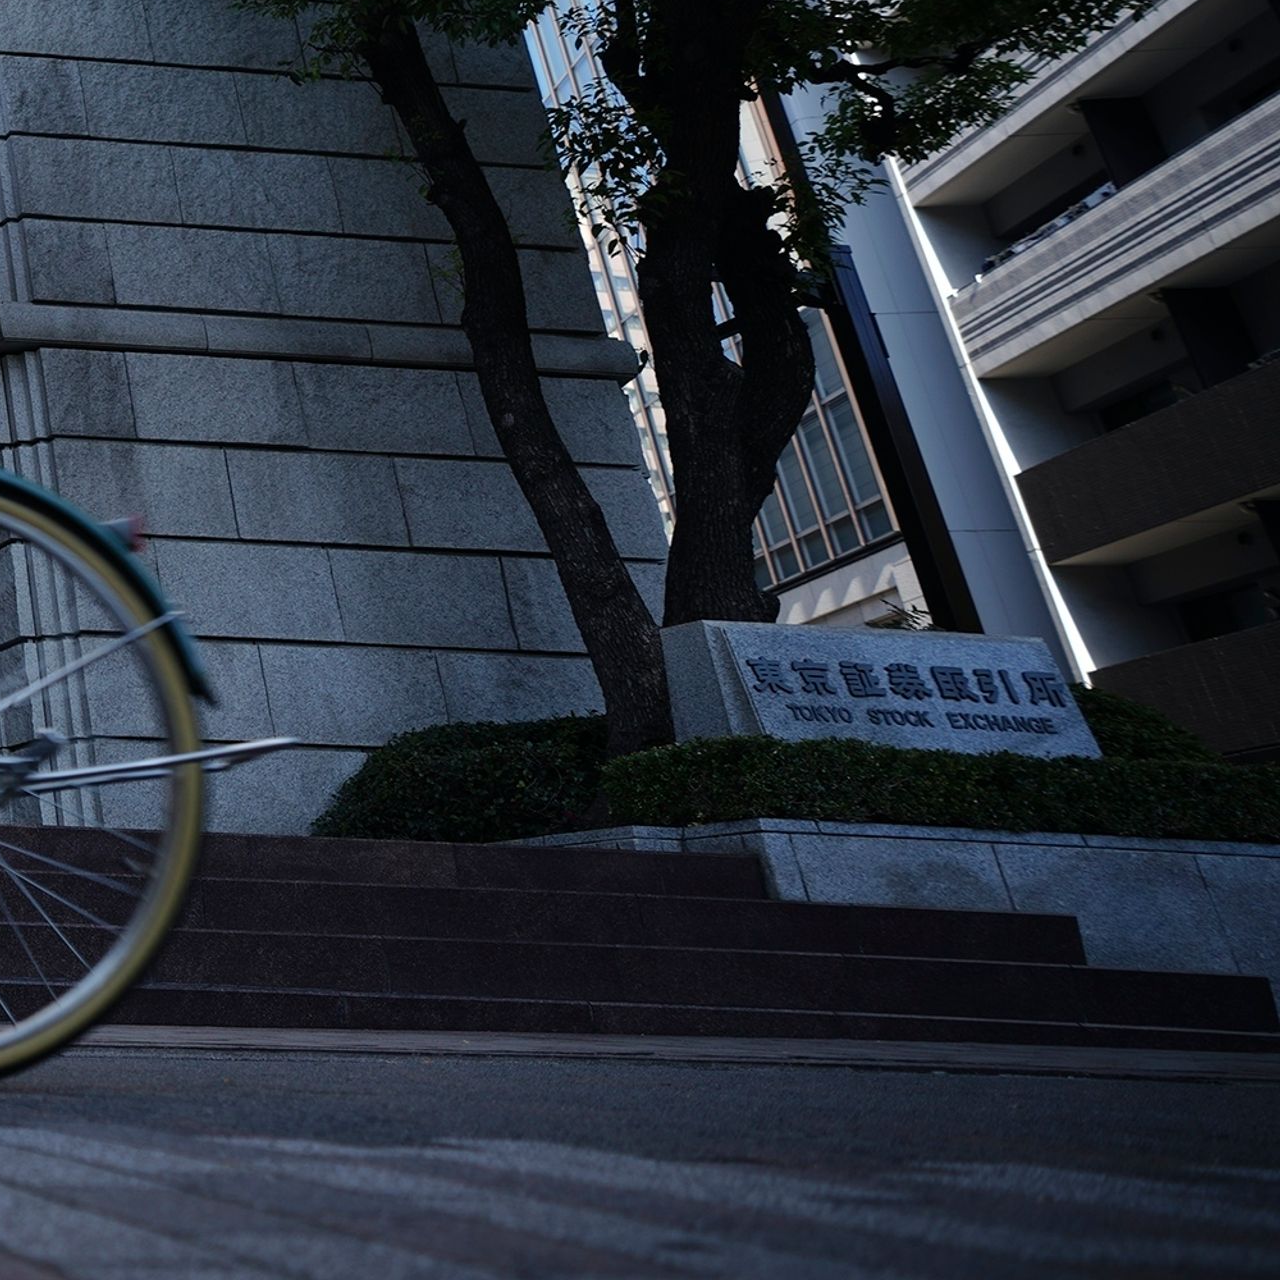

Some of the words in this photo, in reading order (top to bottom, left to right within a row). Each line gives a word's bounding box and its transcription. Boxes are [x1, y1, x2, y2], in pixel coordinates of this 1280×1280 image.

[745, 656, 1068, 709] 東京証券取引所
[786, 702, 853, 725] TOKYO
[867, 708, 934, 729] STOCK
[946, 712, 1059, 736] EXCHANGE
